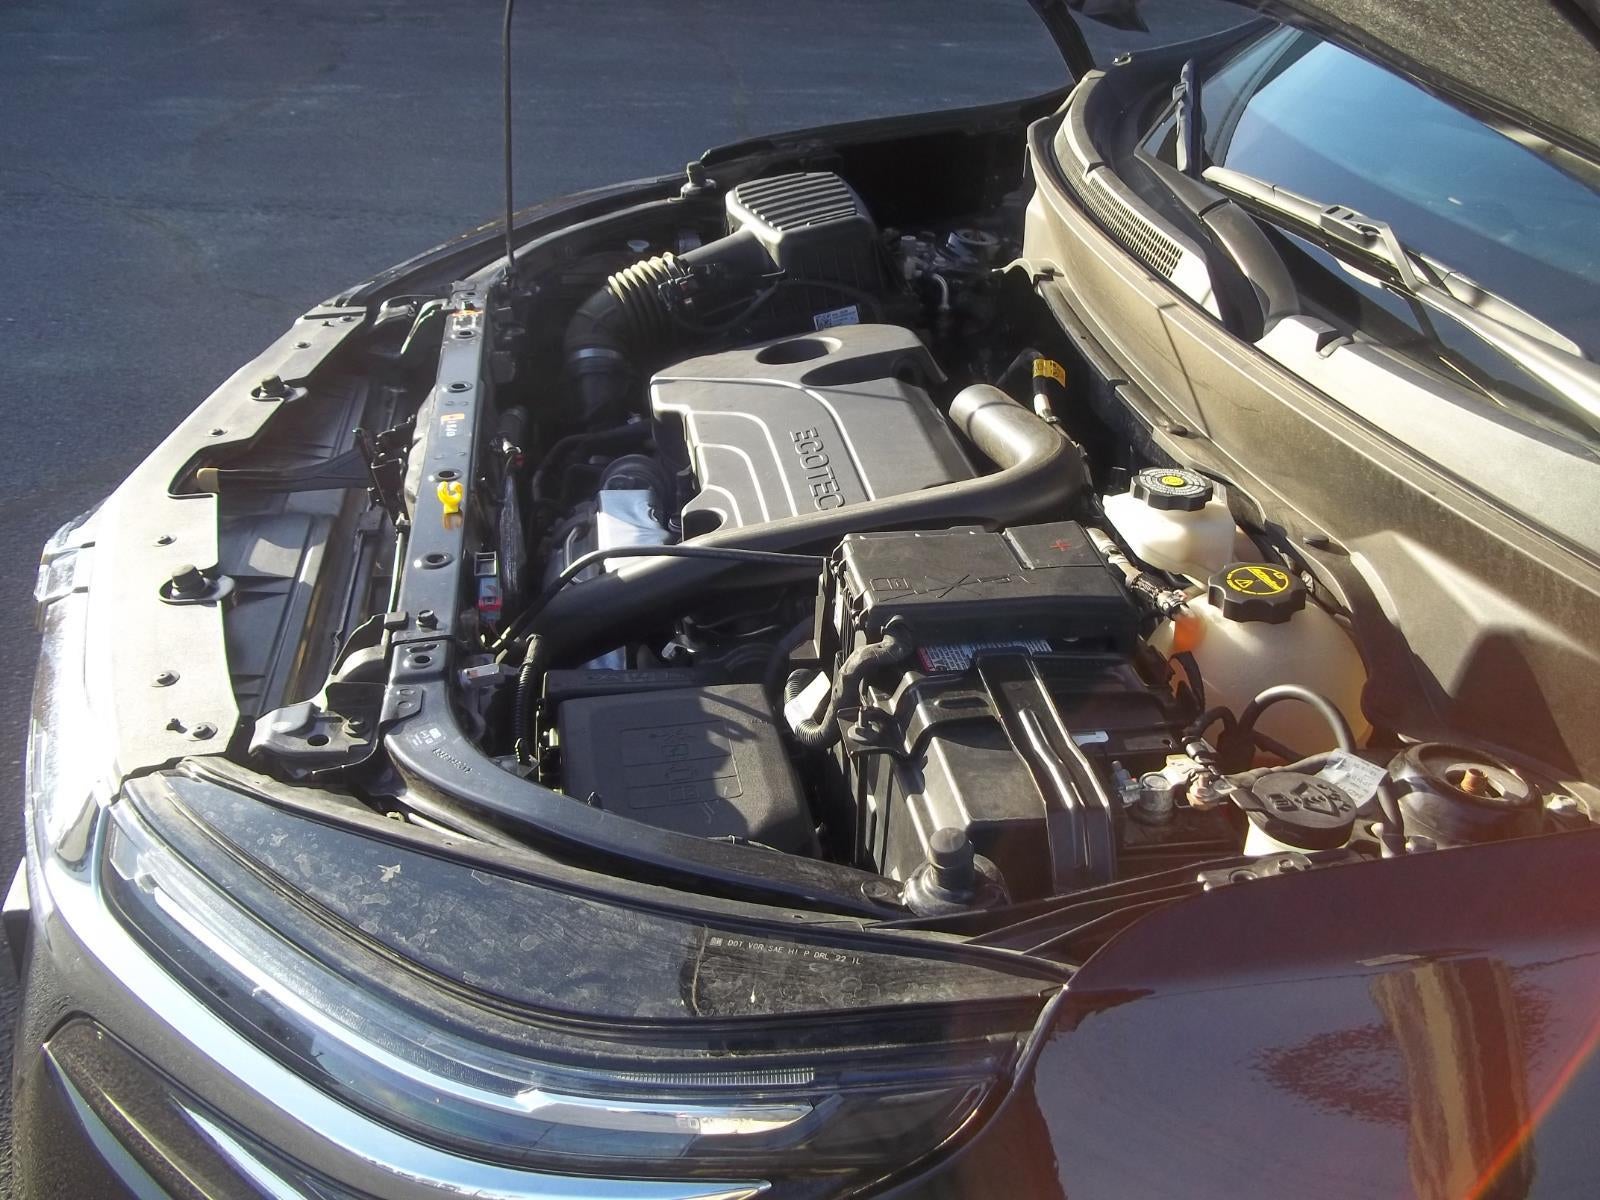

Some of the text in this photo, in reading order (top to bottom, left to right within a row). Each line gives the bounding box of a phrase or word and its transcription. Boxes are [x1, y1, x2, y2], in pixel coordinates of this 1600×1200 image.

[789, 426, 846, 511] ECOTEC
[727, 939, 743, 948] DOT
[767, 945, 784, 953] SAE
[813, 951, 829, 960] DRL
